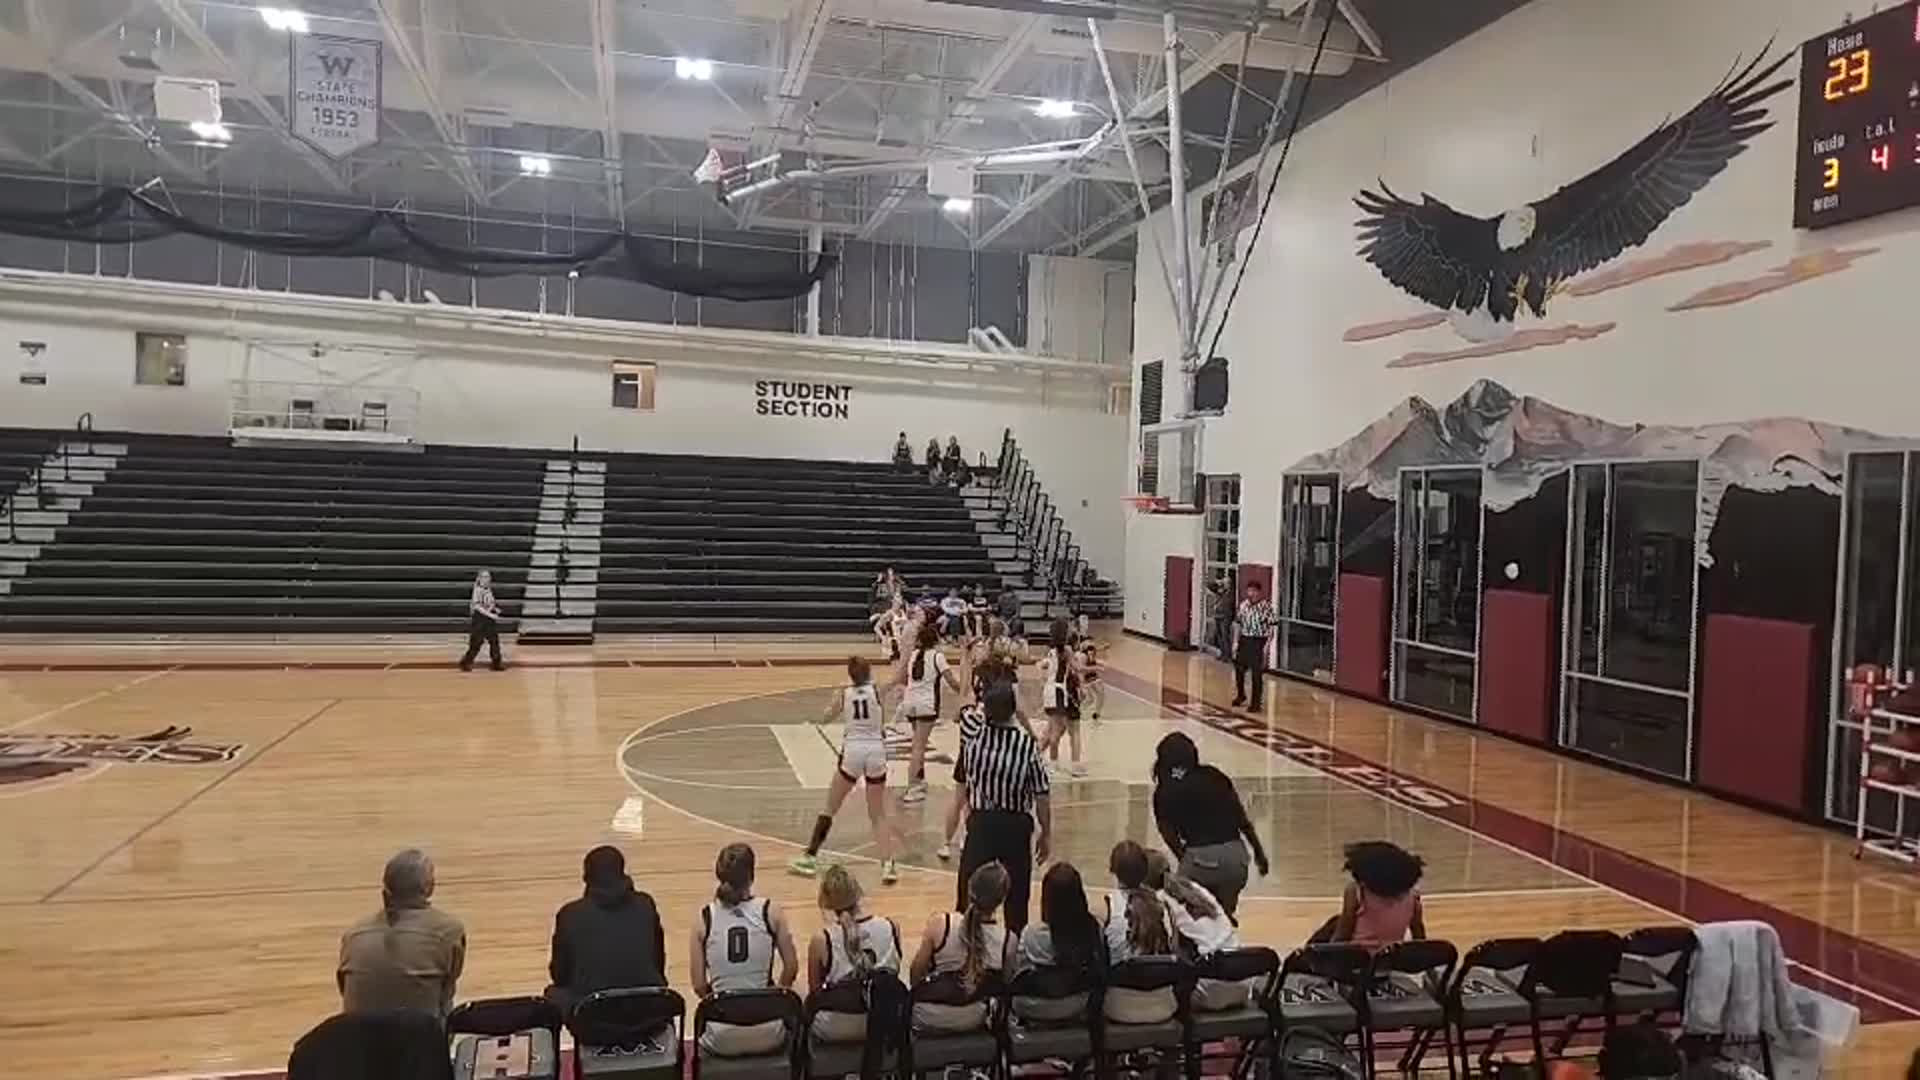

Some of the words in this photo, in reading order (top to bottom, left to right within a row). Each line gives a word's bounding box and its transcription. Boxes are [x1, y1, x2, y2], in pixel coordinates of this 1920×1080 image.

[317, 55, 354, 76] W
[1824, 49, 1869, 100] 23
[316, 80, 357, 94] STATE
[297, 90, 377, 110] CHAMPIONS
[313, 107, 359, 128] 1953
[1871, 144, 1889, 170] 4
[1823, 157, 1839, 188] 3
[755, 381, 853, 401] STUDENT
[756, 399, 848, 419] SECTION
[852, 699, 869, 720] 11
[727, 926, 749, 963] 0
